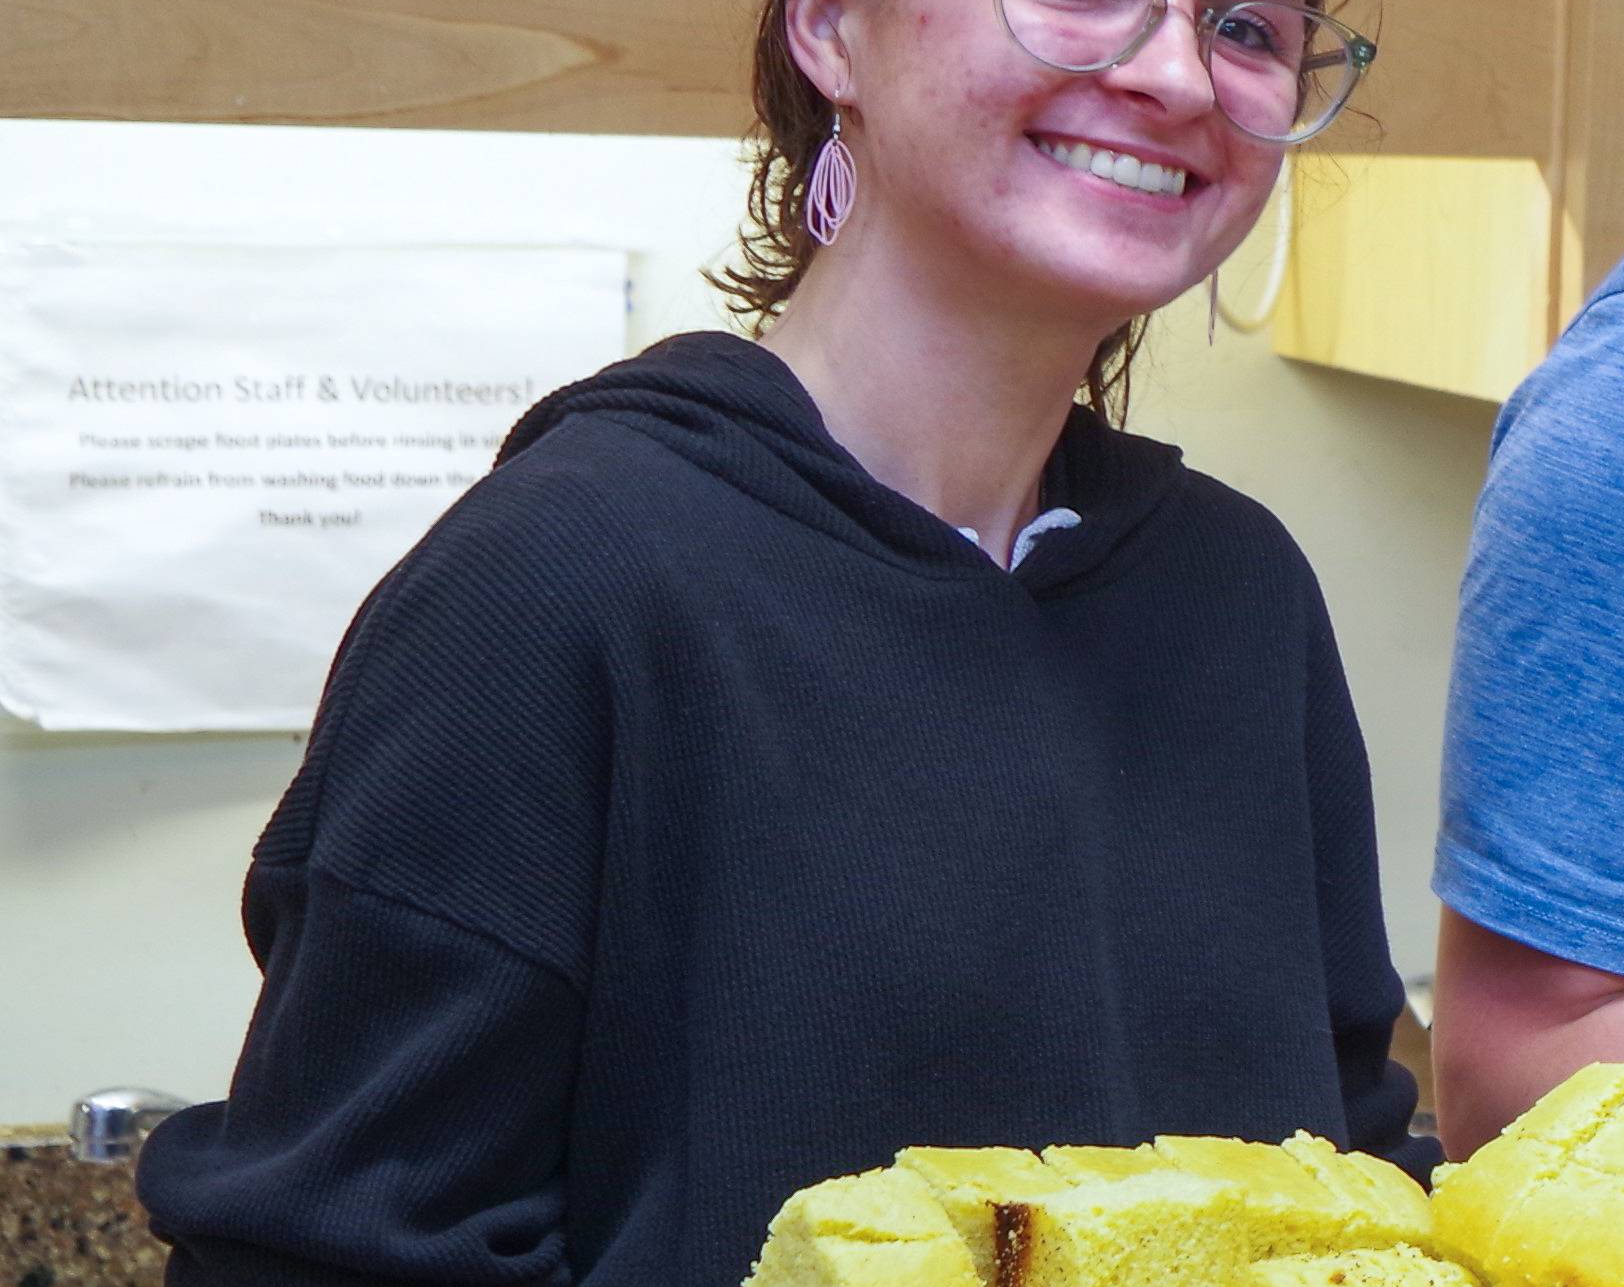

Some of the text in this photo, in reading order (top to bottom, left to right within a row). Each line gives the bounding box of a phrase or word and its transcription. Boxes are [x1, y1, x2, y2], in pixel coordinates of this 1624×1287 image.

[68, 375, 534, 404] Attention Staff & Volunteers!
[79, 432, 141, 449] Please
[215, 431, 260, 449] food
[327, 432, 387, 449] before
[69, 471, 131, 488] Please
[136, 471, 202, 488] refrain
[207, 469, 255, 488] from
[343, 470, 385, 487] food
[259, 510, 361, 532] Thank you!
